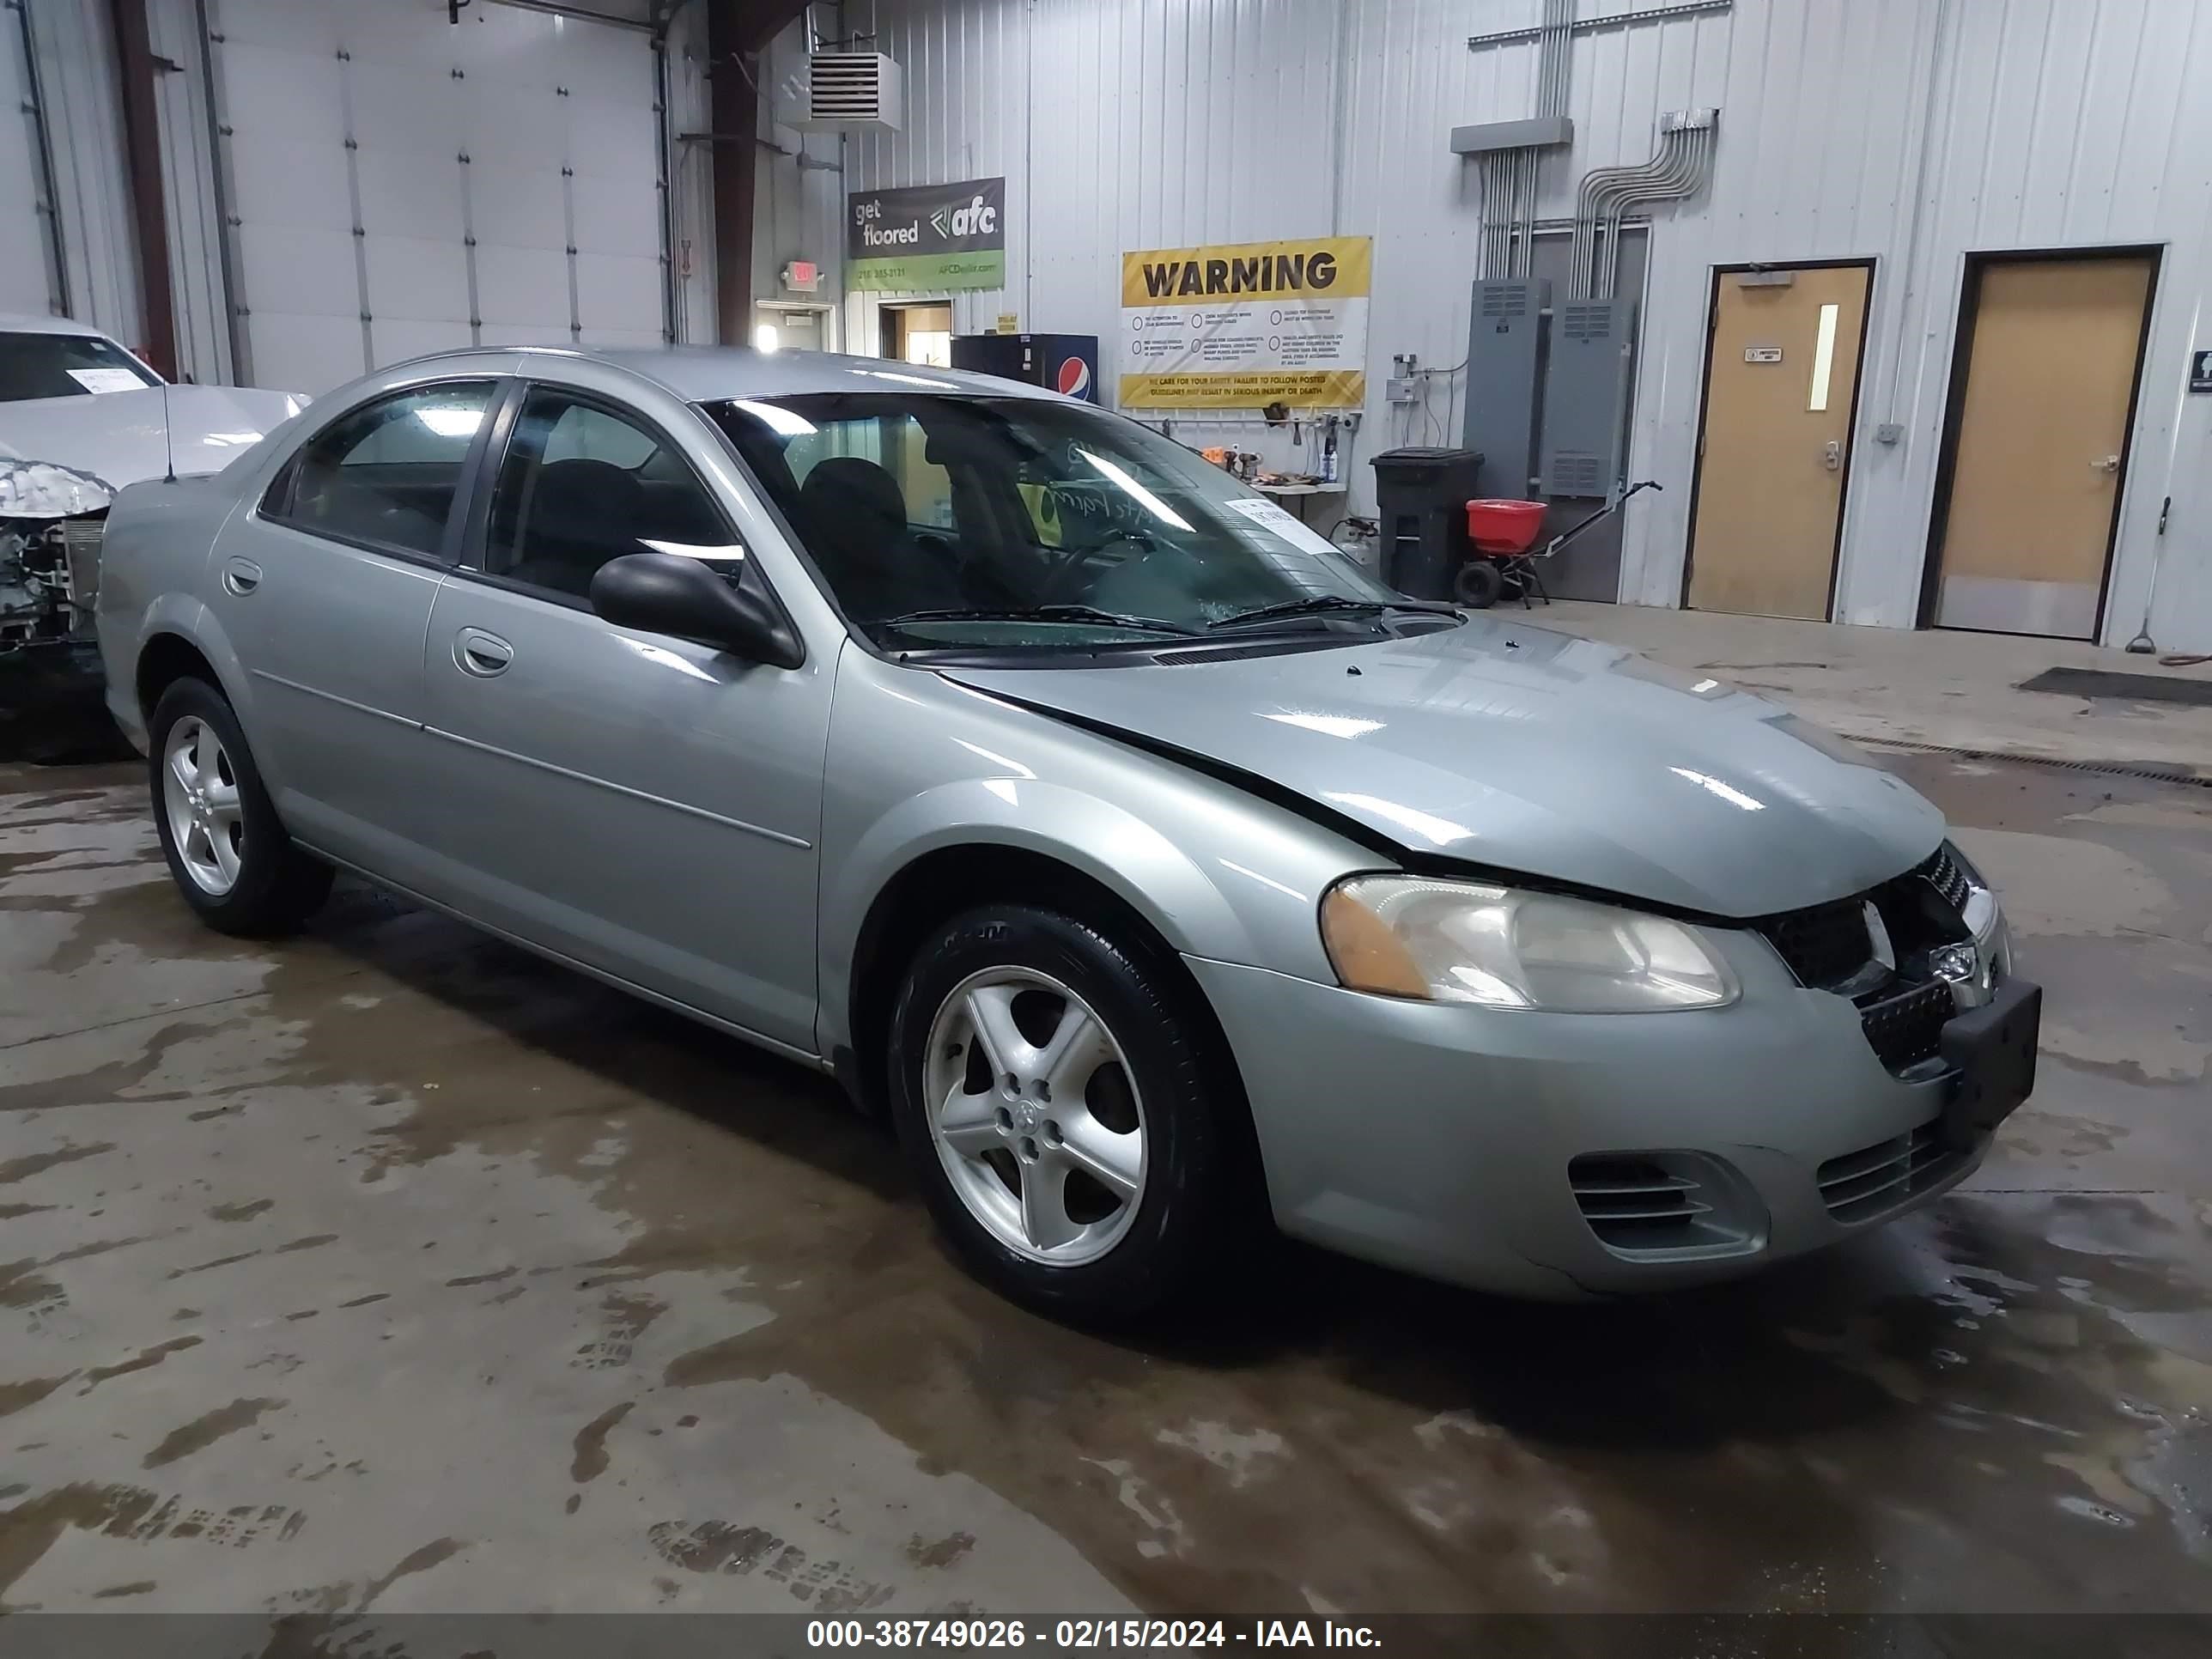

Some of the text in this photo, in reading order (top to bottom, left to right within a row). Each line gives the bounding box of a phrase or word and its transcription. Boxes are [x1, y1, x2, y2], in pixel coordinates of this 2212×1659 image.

[855, 199, 881, 225] get
[951, 196, 996, 236] afc
[863, 220, 919, 246] floored
[1142, 252, 1337, 298] WARNING
